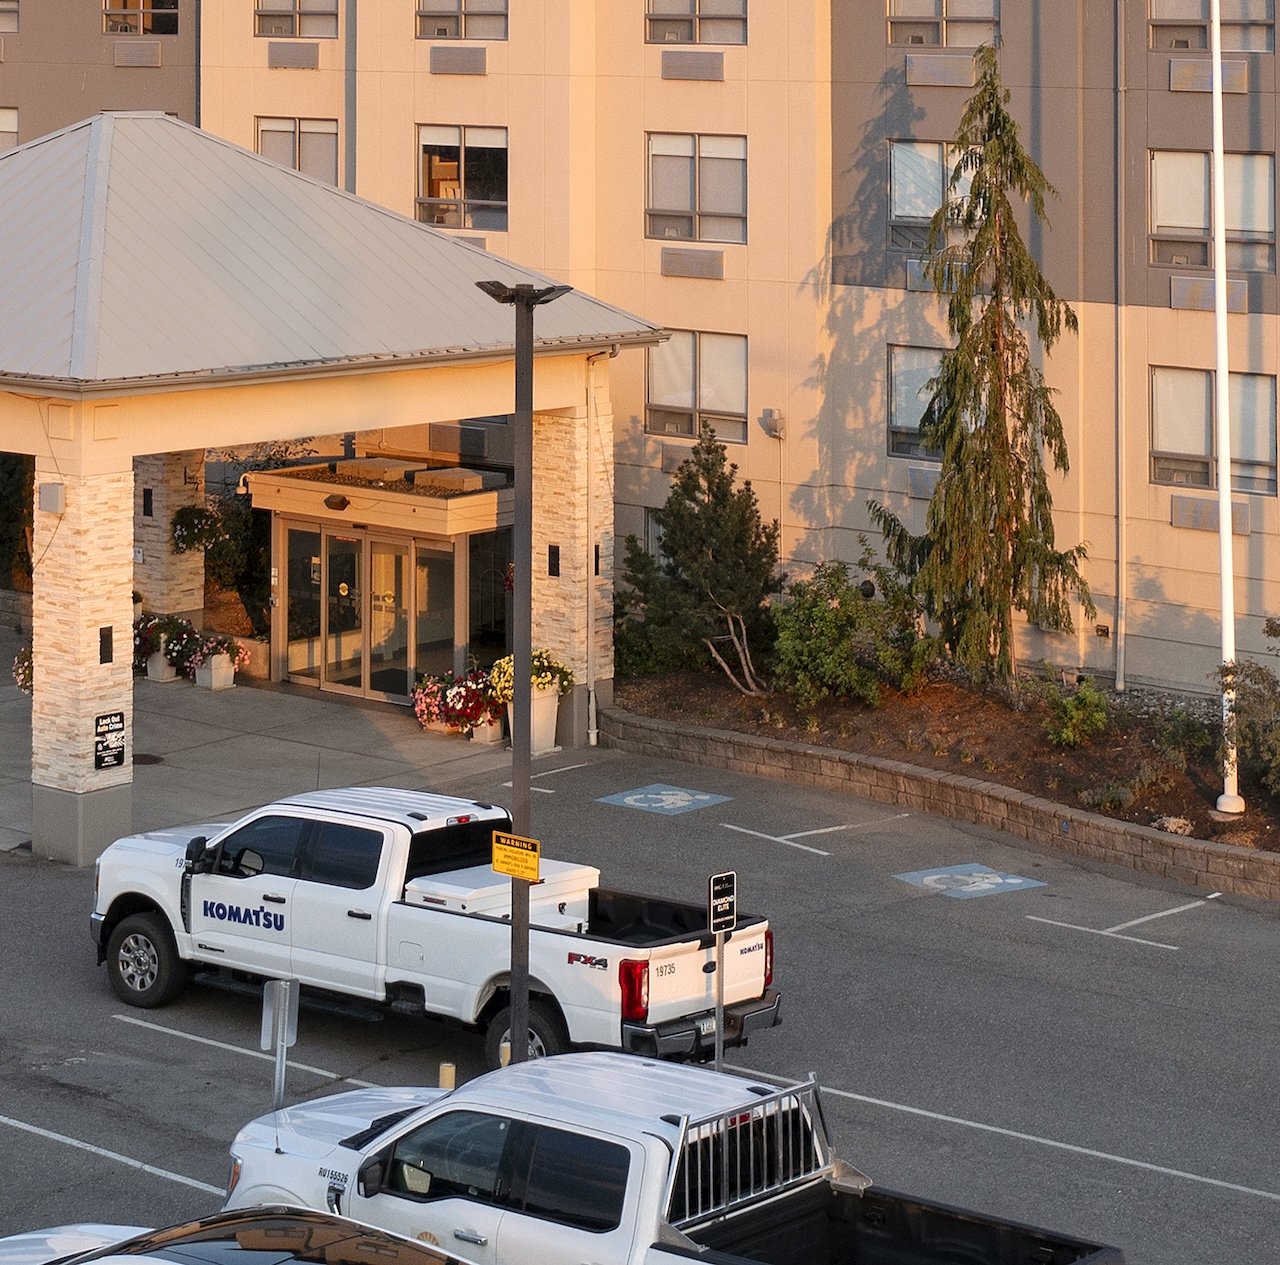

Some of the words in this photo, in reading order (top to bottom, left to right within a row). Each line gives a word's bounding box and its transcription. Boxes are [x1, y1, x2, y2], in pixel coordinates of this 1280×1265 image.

[500, 836, 533, 850] WARNING
[203, 899, 285, 932] KOMATSU
[740, 942, 764, 956] KOMATSU
[567, 951, 609, 969] FX4
[656, 962, 676, 977] 19735
